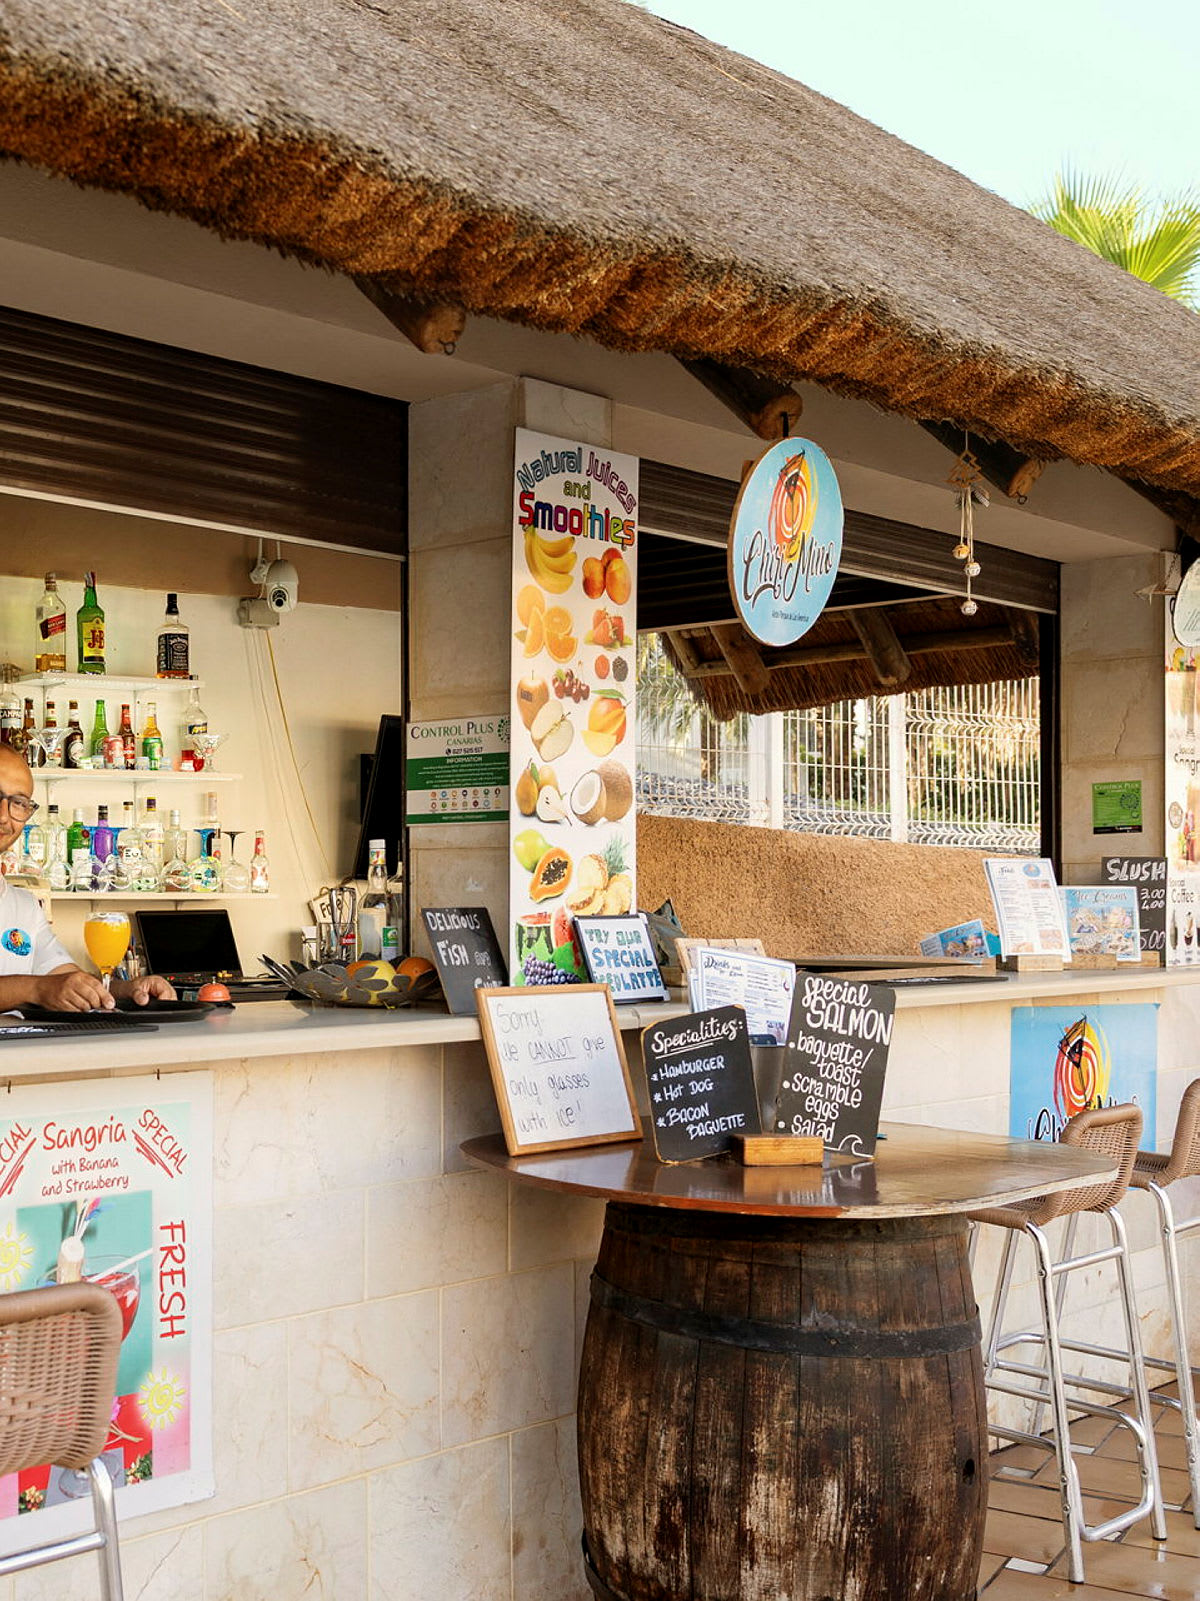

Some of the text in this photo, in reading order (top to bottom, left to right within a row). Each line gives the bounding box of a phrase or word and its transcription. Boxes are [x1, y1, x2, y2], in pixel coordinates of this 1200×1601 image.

[516, 447, 636, 515] Natural Juices
[563, 480, 591, 500] and
[519, 491, 636, 546] Smoothies
[410, 721, 494, 739] CONTROL PLUS
[1106, 858, 1166, 882] SLUSH
[585, 929, 609, 944] TRY
[497, 1003, 543, 1036] Sorry
[806, 997, 894, 1046] SALMON
[548, 1072, 591, 1099] glasses
[818, 1058, 862, 1088] toast
[689, 1080, 715, 1096] DOG
[666, 1103, 710, 1126] BACON
[805, 1095, 840, 1121] eggs
[686, 1113, 746, 1141] BAGUETTE
[43, 1115, 127, 1152] Sangria
[138, 1109, 190, 1175] SPECIAL
[52, 1156, 120, 1175] with Banana
[42, 1175, 129, 1197] and Strawberry
[160, 1220, 185, 1339] FRESH
